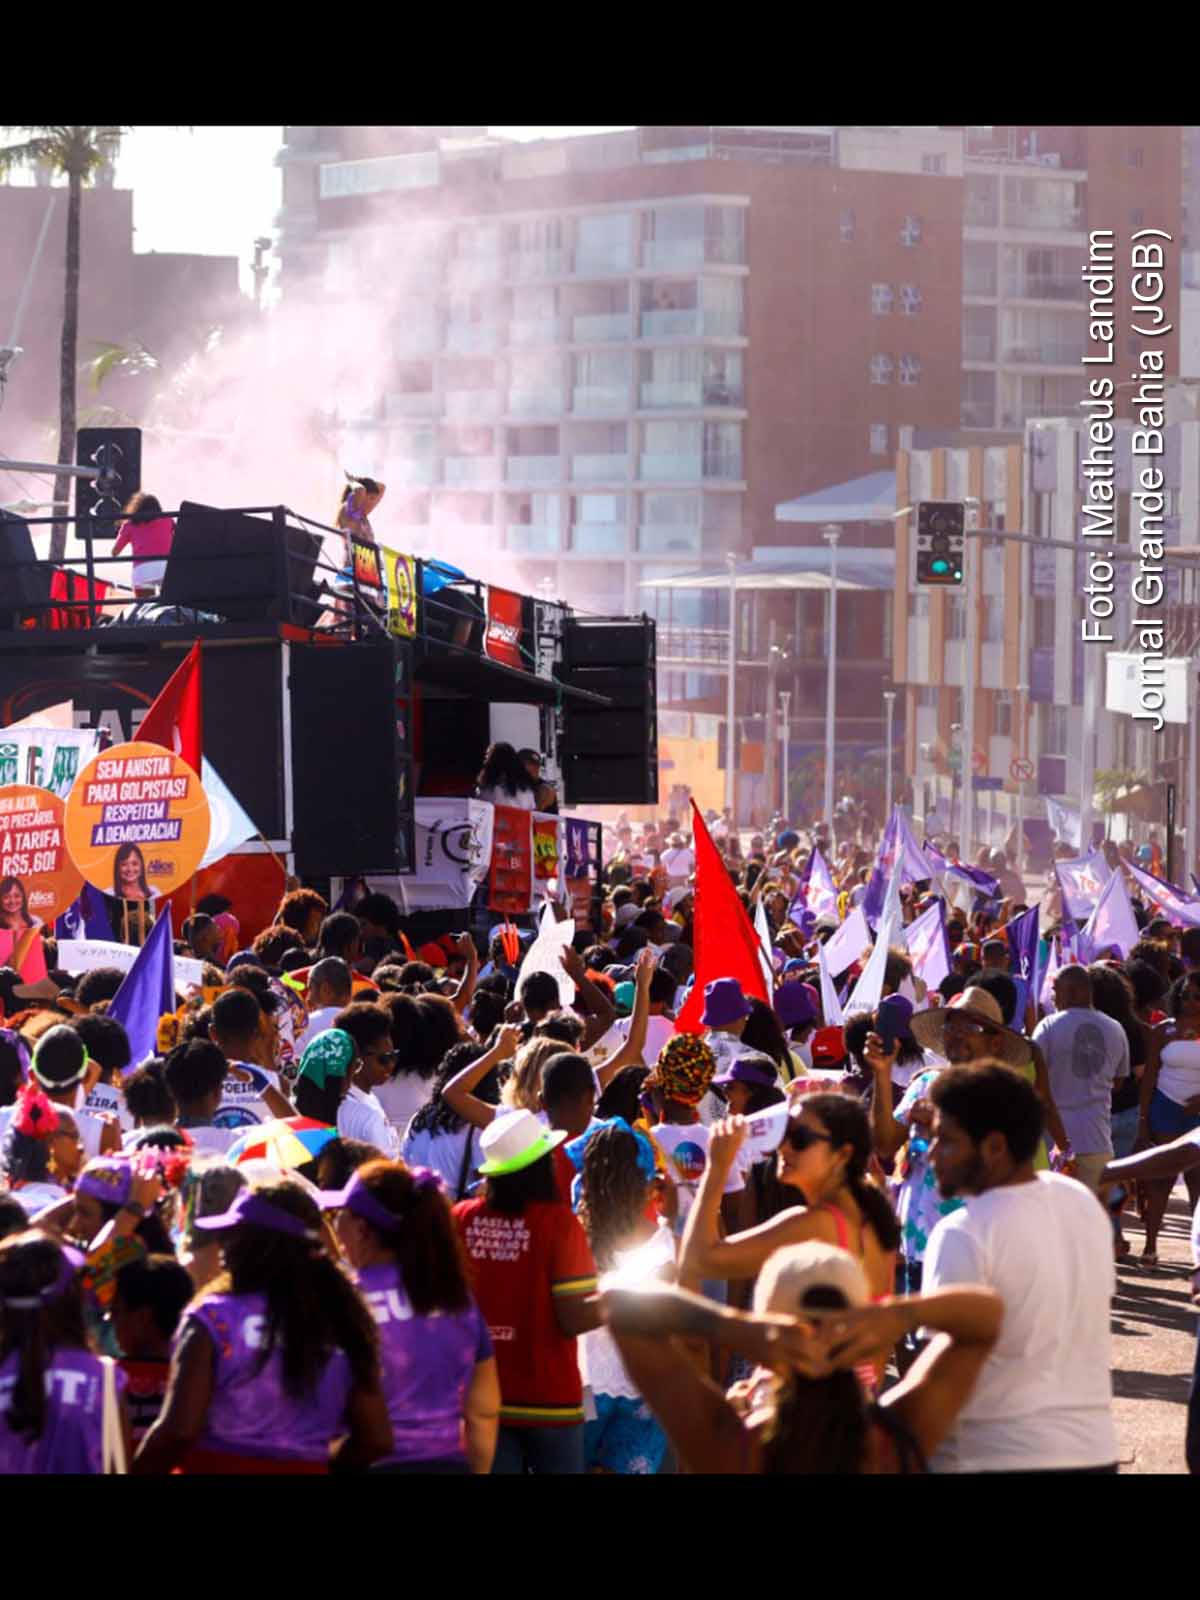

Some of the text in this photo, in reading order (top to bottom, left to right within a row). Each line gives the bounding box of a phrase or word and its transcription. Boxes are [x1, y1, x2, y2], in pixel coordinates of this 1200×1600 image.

[96, 757, 172, 780] SEM ANISTIA
[87, 778, 187, 804] PARA GOLPISTAS!
[104, 801, 166, 823] RESPEITEM
[15, 828, 60, 851] TARIFA
[94, 821, 180, 844] A DEMOCRACIA!
[86, 1096, 119, 1111] EIRA
